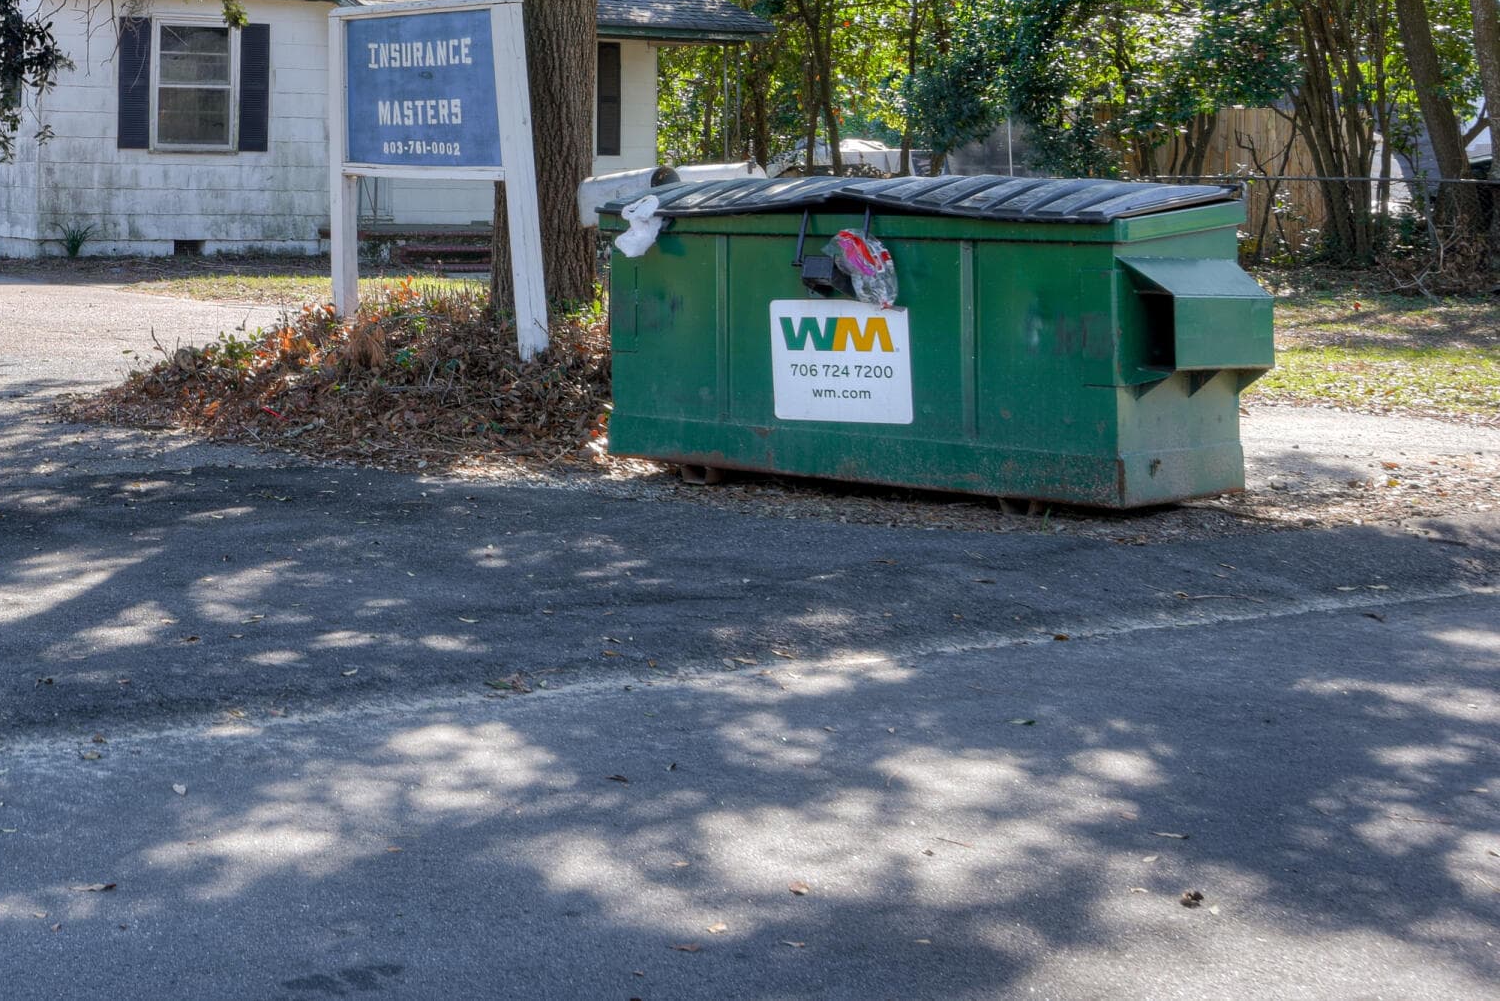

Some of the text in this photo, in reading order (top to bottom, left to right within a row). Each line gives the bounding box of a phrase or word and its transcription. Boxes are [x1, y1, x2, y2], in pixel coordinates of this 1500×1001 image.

[368, 37, 472, 69] INSURANCE
[378, 99, 462, 126] MASTERS
[779, 316, 895, 353] WM
[790, 363, 894, 379] 706 724 7200
[812, 387, 872, 400] wm.com
